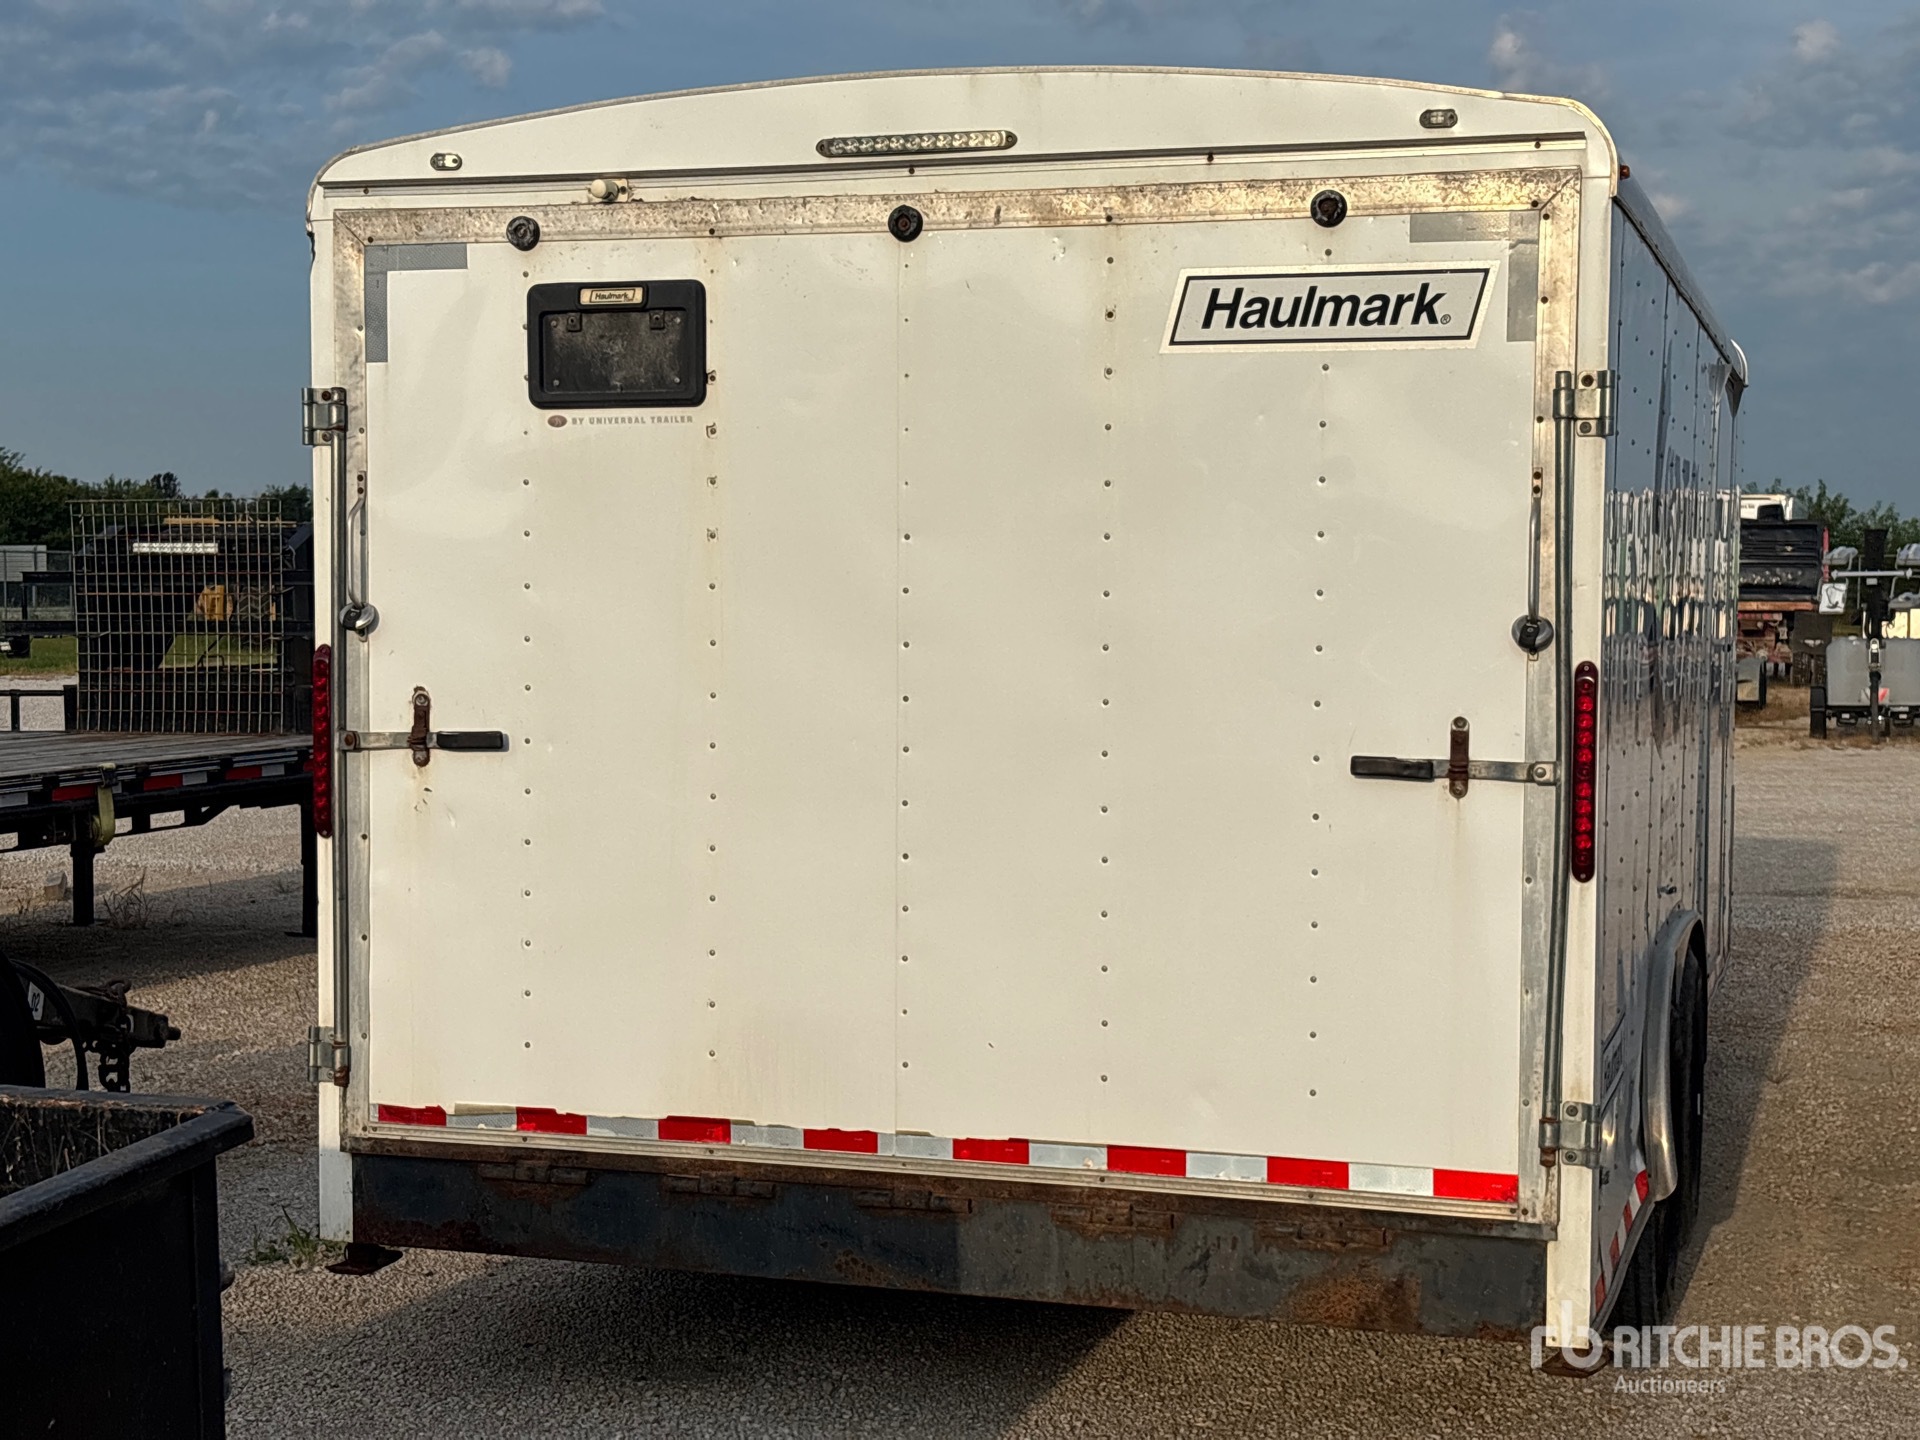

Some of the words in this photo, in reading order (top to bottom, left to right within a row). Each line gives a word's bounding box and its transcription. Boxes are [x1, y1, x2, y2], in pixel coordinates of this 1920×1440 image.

[594, 292, 629, 301] Haulmark
[571, 417, 585, 425] BY
[588, 416, 647, 425] UNIVERSAL
[651, 415, 693, 424] TRAILER
